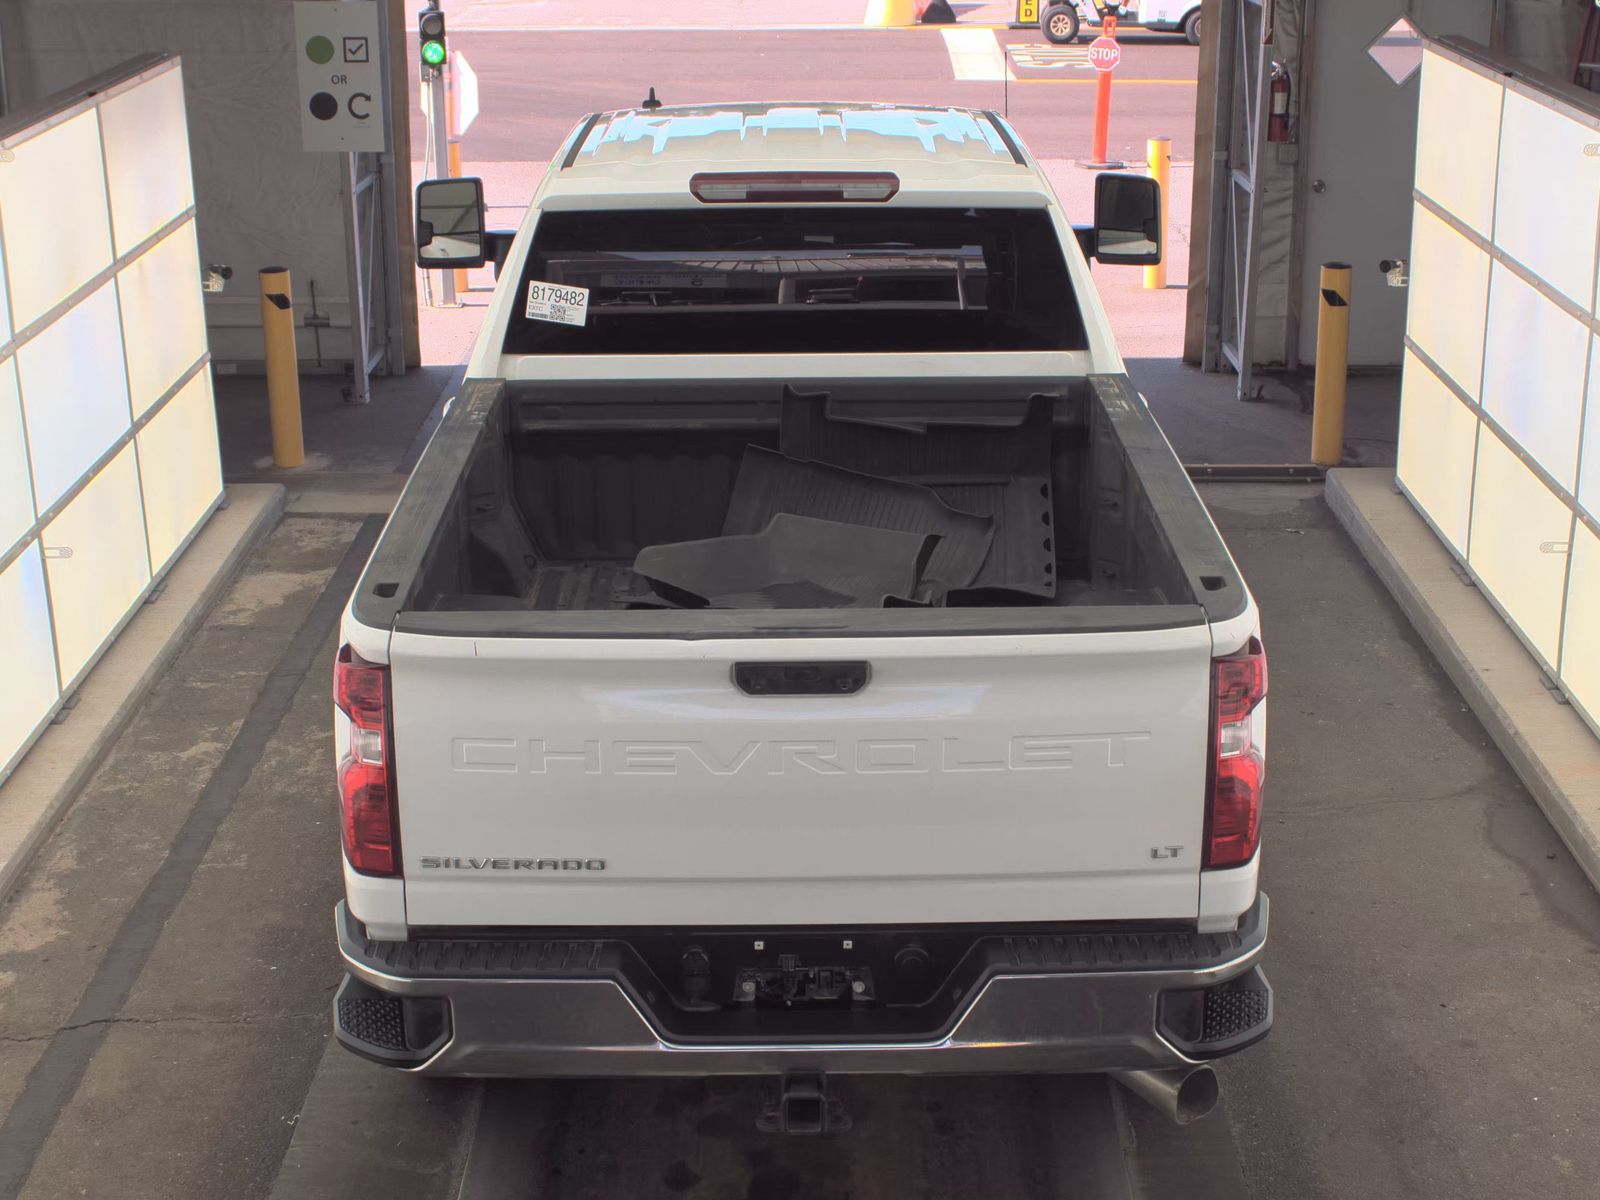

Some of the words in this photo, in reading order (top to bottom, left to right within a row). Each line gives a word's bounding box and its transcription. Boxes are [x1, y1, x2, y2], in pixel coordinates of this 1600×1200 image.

[1090, 47, 1118, 61] STOP
[331, 75, 347, 85] OR
[531, 285, 585, 306] 8179482
[451, 733, 1151, 776] CHEVROLET
[1151, 846, 1184, 858] LT
[420, 856, 607, 871] SILVERADO
